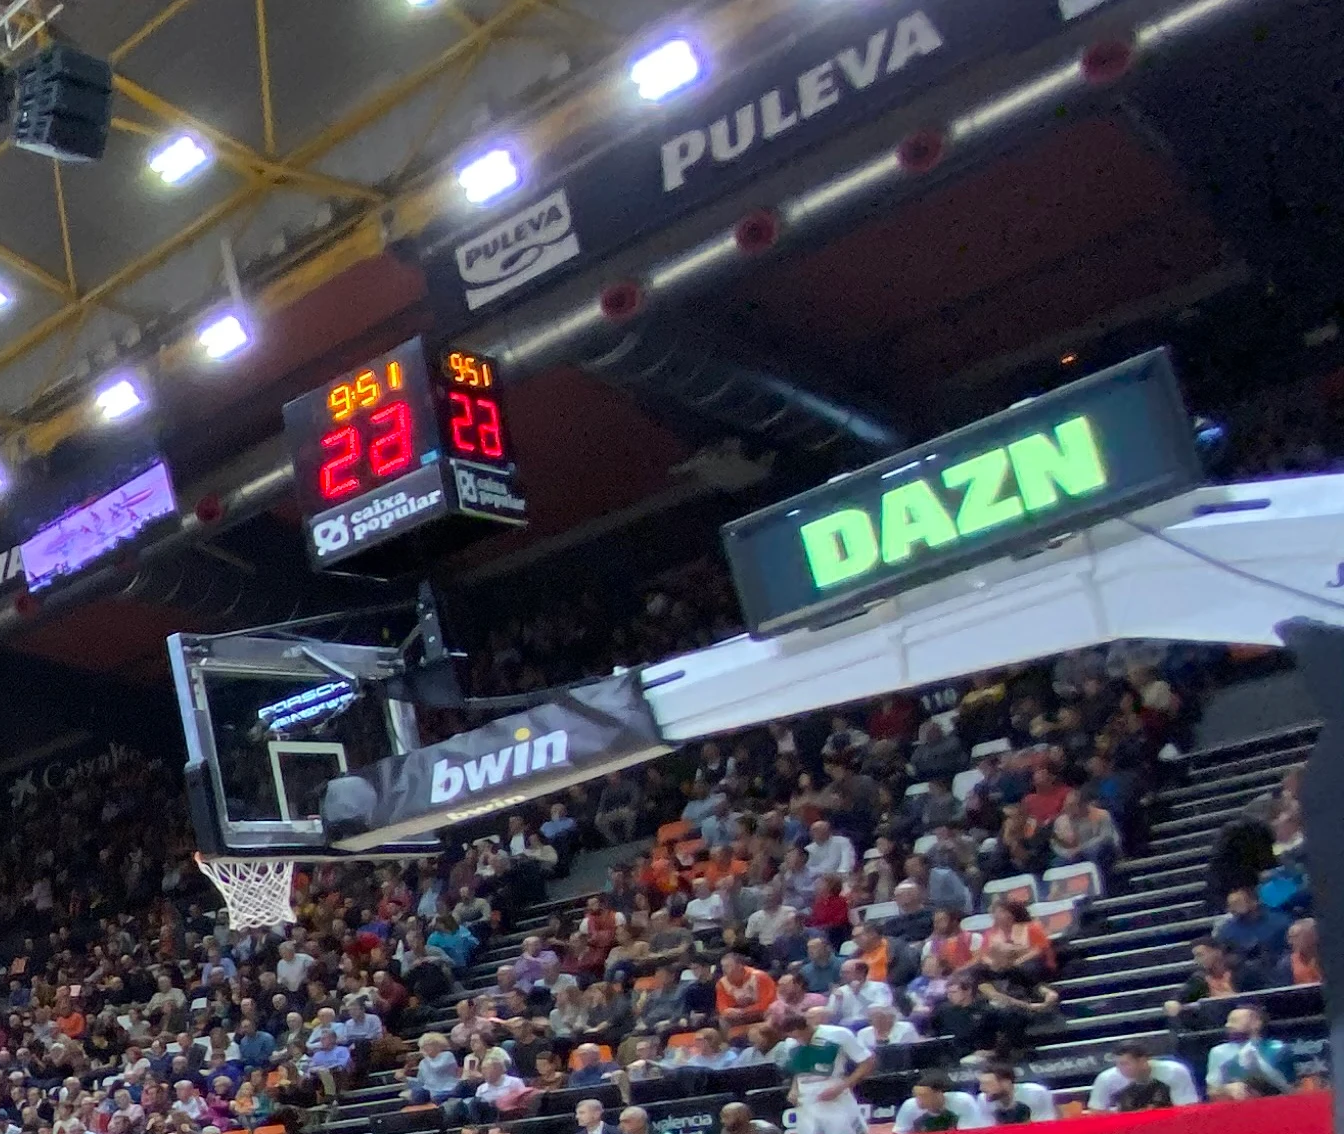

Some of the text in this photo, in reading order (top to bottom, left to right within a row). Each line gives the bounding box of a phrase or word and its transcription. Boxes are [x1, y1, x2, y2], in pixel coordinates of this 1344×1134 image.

[661, 10, 944, 194] PULEVA
[466, 205, 562, 269] PULEVA
[329, 362, 401, 420] 9:51
[350, 491, 407, 524] caixa
[353, 489, 442, 541] popular
[800, 415, 1107, 590] DAZN
[430, 726, 569, 805] bwin
[651, 1112, 713, 1131] valencia
